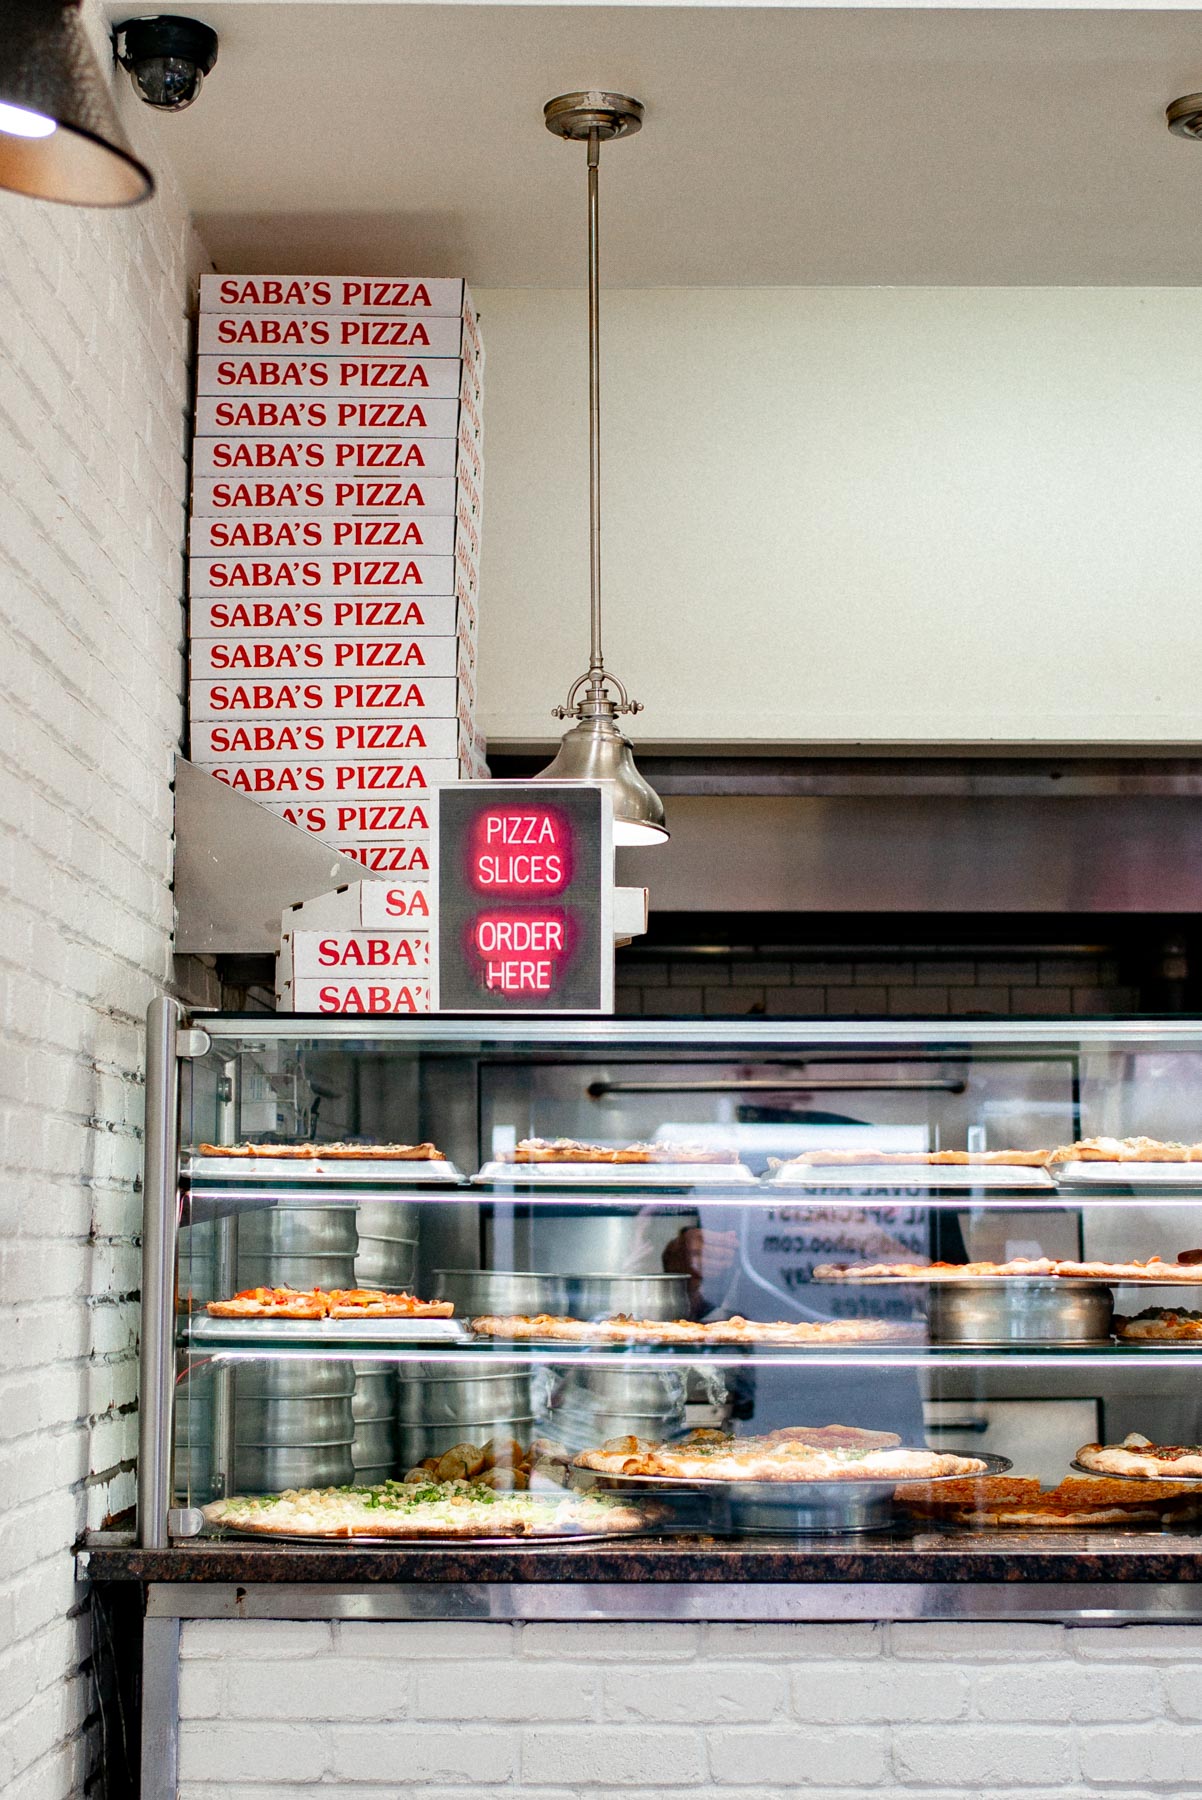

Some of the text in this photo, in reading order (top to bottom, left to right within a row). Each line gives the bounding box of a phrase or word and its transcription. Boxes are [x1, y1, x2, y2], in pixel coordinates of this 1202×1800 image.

[220, 281, 432, 306] SABA'S PIZZA
[218, 320, 430, 346] SABA'S PIZZA
[217, 362, 428, 387] SABA'S PIZZA
[216, 403, 426, 427] SABA'S PIZZA
[213, 444, 425, 467] SABA'S PIZZA
[212, 483, 425, 507] SABA'S PIZZA
[210, 522, 423, 547] SABA'S PIZZA
[209, 562, 422, 587] SABA'S PIZZA
[210, 602, 424, 628] SABA'S PIZZA
[211, 643, 425, 669] SABA'S PIZZA
[210, 684, 425, 710] SABA'S PIZZA
[211, 725, 426, 752] SABA'S PIZZA
[336, 765, 427, 790] PIZZA
[337, 806, 429, 831] PIZZA
[487, 816, 555, 844] PIZZA
[478, 855, 562, 884] SLICES
[478, 921, 562, 952] ORDER
[318, 939, 429, 966] SABA'
[488, 961, 552, 990] HERE
[319, 986, 429, 1014] SABA'
